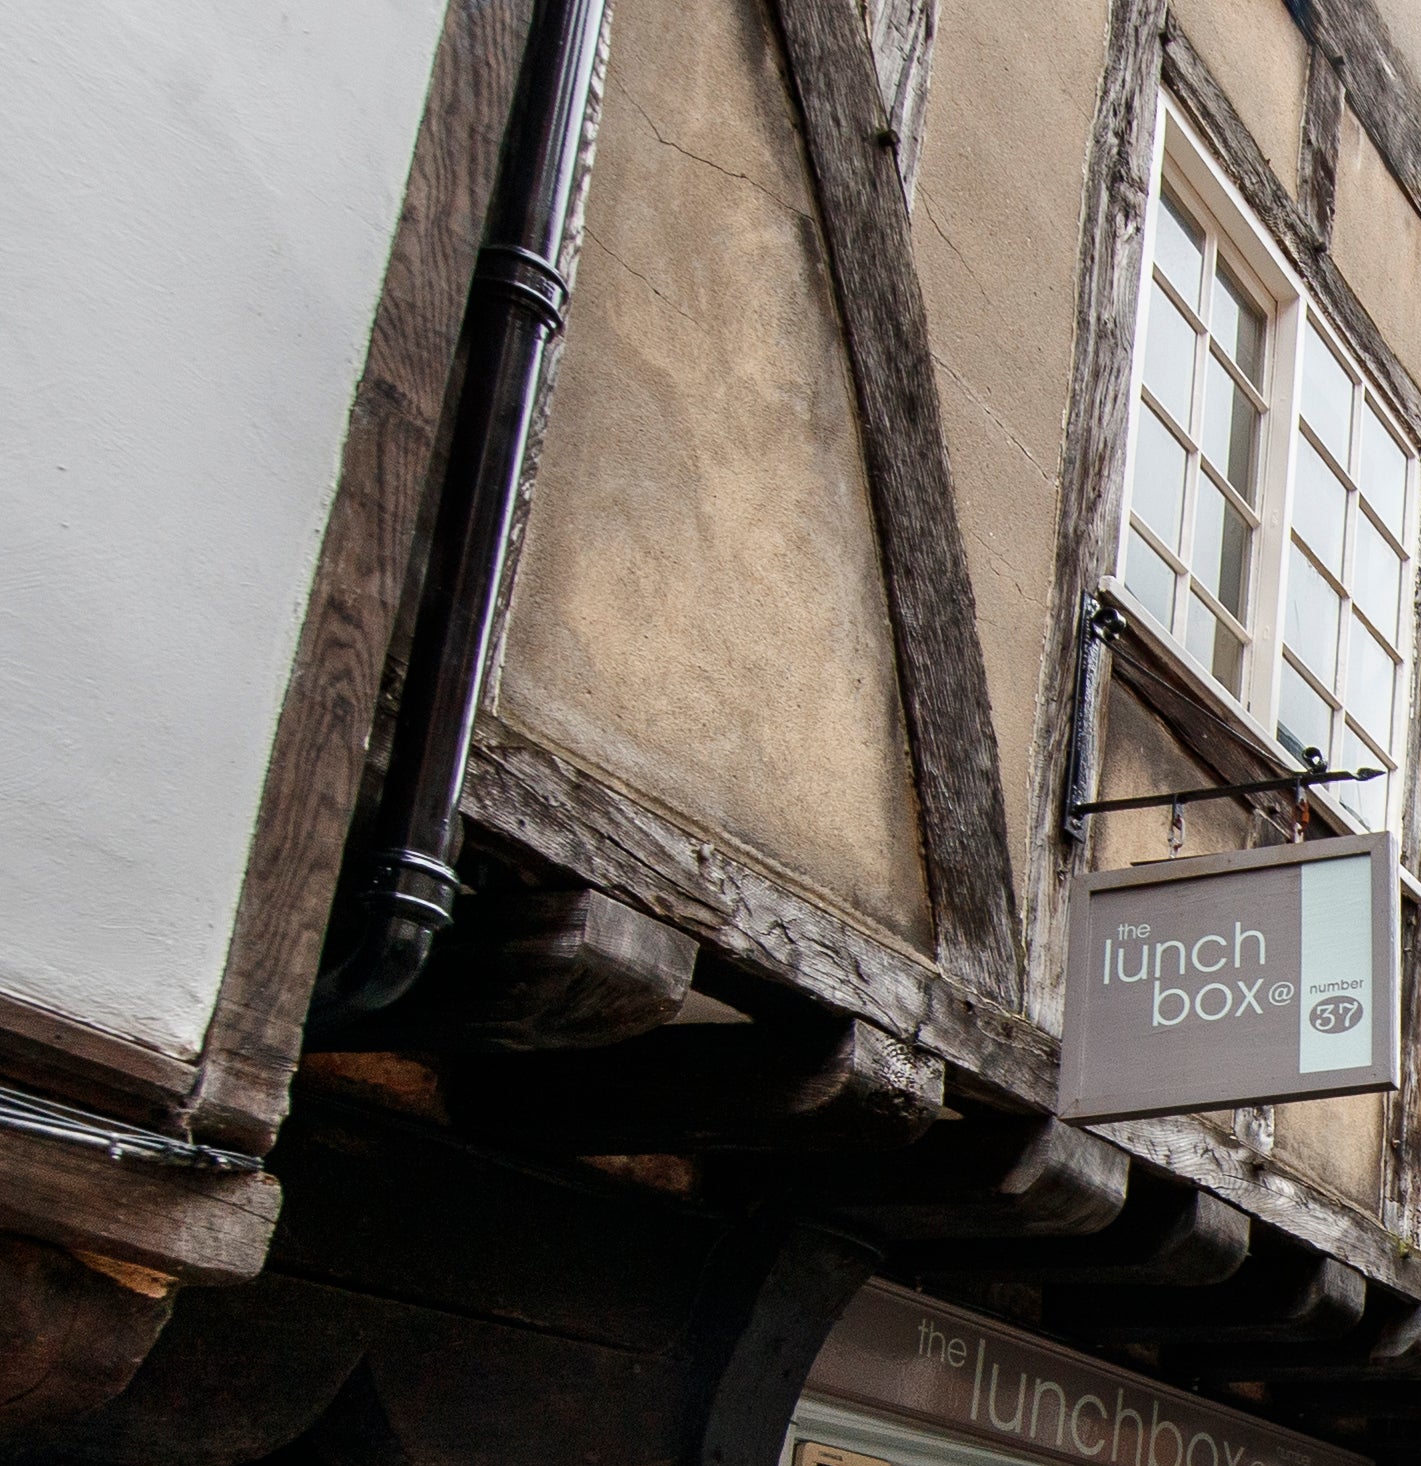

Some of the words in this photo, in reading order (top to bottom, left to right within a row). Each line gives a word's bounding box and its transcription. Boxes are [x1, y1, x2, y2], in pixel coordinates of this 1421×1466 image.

[1118, 922, 1151, 941] the
[1103, 921, 1266, 985] lunch
[1310, 978, 1365, 995] number
[1315, 1001, 1359, 1031] 37
[918, 1319, 967, 1368] the
